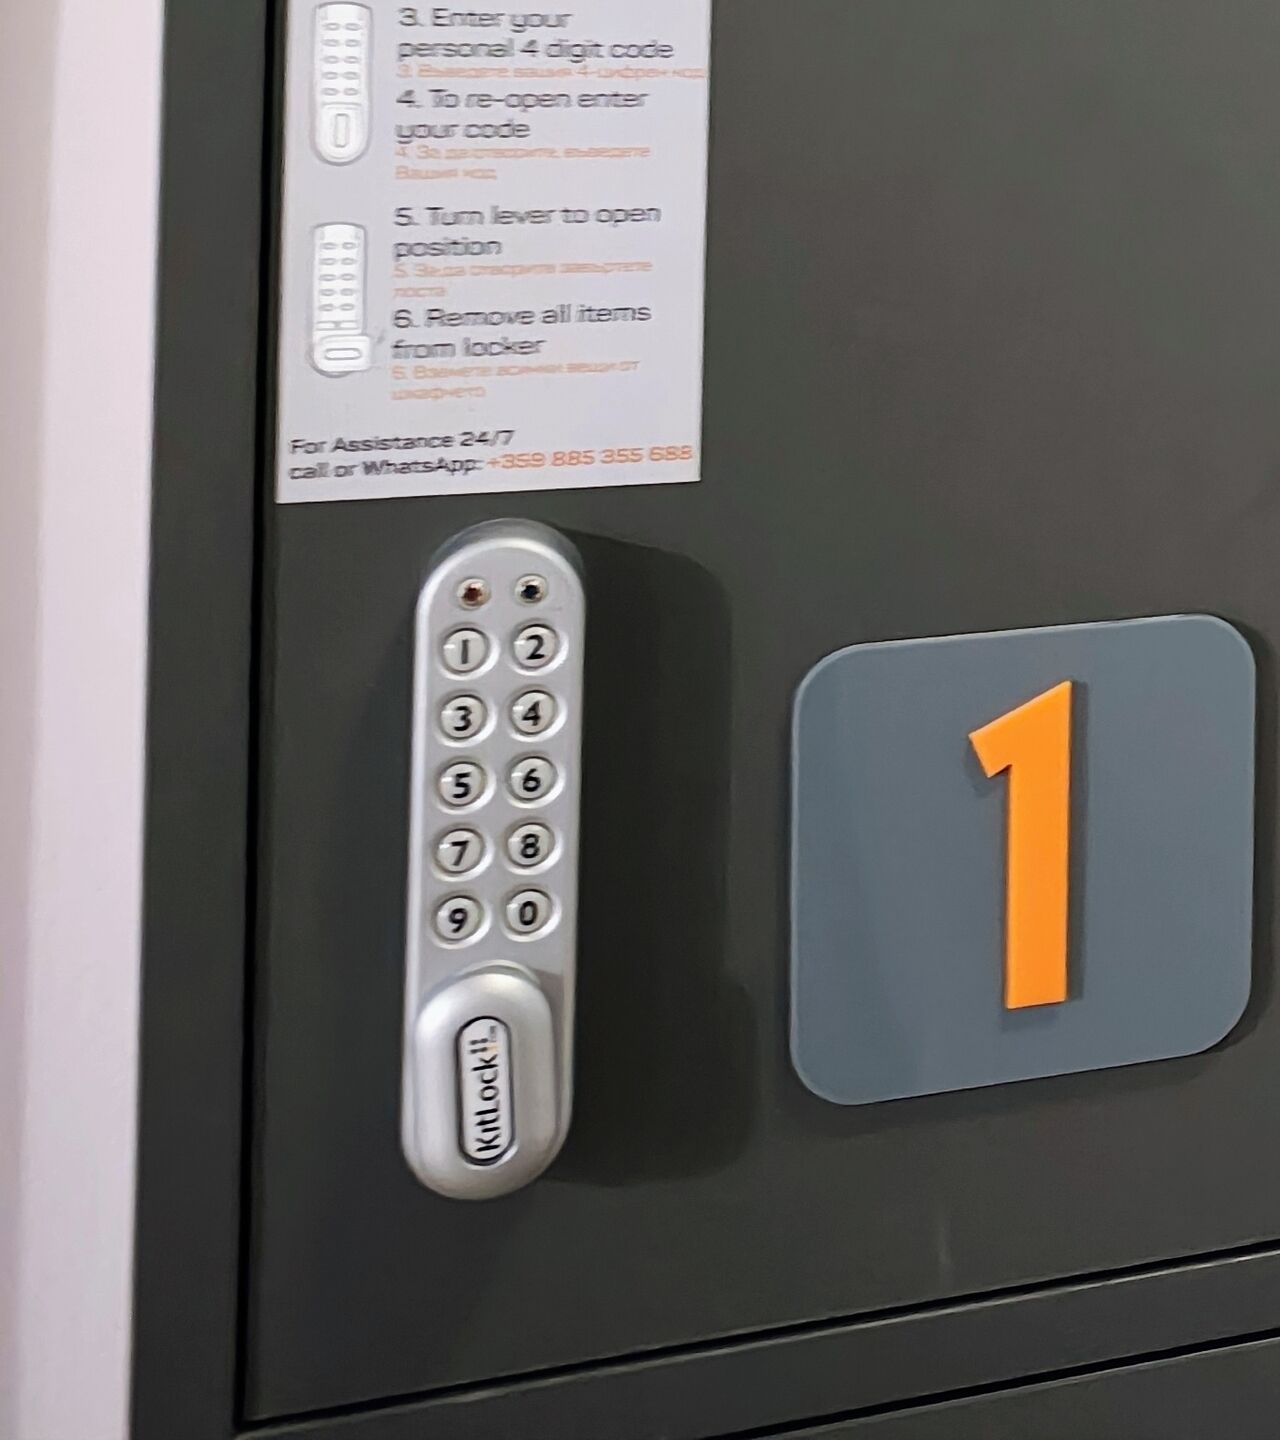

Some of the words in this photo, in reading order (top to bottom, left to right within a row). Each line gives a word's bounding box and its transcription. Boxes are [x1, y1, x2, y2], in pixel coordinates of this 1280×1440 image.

[398, 7, 424, 27] 3.
[432, 7, 505, 27] Enter
[510, 12, 573, 34] your
[398, 38, 515, 62] personal
[519, 39, 540, 57] 4
[546, 38, 605, 63] digit
[610, 39, 675, 58] code
[396, 89, 424, 108] 4.
[427, 89, 460, 108] To
[464, 93, 572, 112] re-open
[577, 91, 650, 108] enter
[395, 124, 460, 144] your
[462, 118, 531, 138] code
[394, 207, 420, 226] 5.
[425, 206, 485, 226] Turn
[490, 205, 557, 225] lever
[560, 207, 589, 223] to
[594, 207, 662, 228] open
[393, 236, 503, 262] position
[394, 308, 420, 329] 6.
[424, 308, 536, 328] Remove
[541, 304, 572, 324] all
[575, 304, 653, 323] items
[391, 339, 456, 359] from
[462, 337, 547, 356] locker
[289, 438, 327, 455] For
[331, 435, 456, 453] Assistance
[460, 429, 515, 447] 24/7
[288, 462, 330, 480] call
[334, 464, 359, 477] or
[487, 451, 546, 469] +359
[601, 447, 643, 464] 355
[461, 639, 469, 664] 1
[526, 635, 544, 660] 2
[454, 705, 471, 731] 3
[523, 701, 540, 725] 4
[453, 773, 471, 798] 5
[523, 768, 539, 792] 6
[452, 840, 468, 866] 7
[521, 833, 539, 858] 8
[967, 680, 1072, 1009] 1
[450, 908, 468, 933] 9
[520, 900, 536, 925] 0
